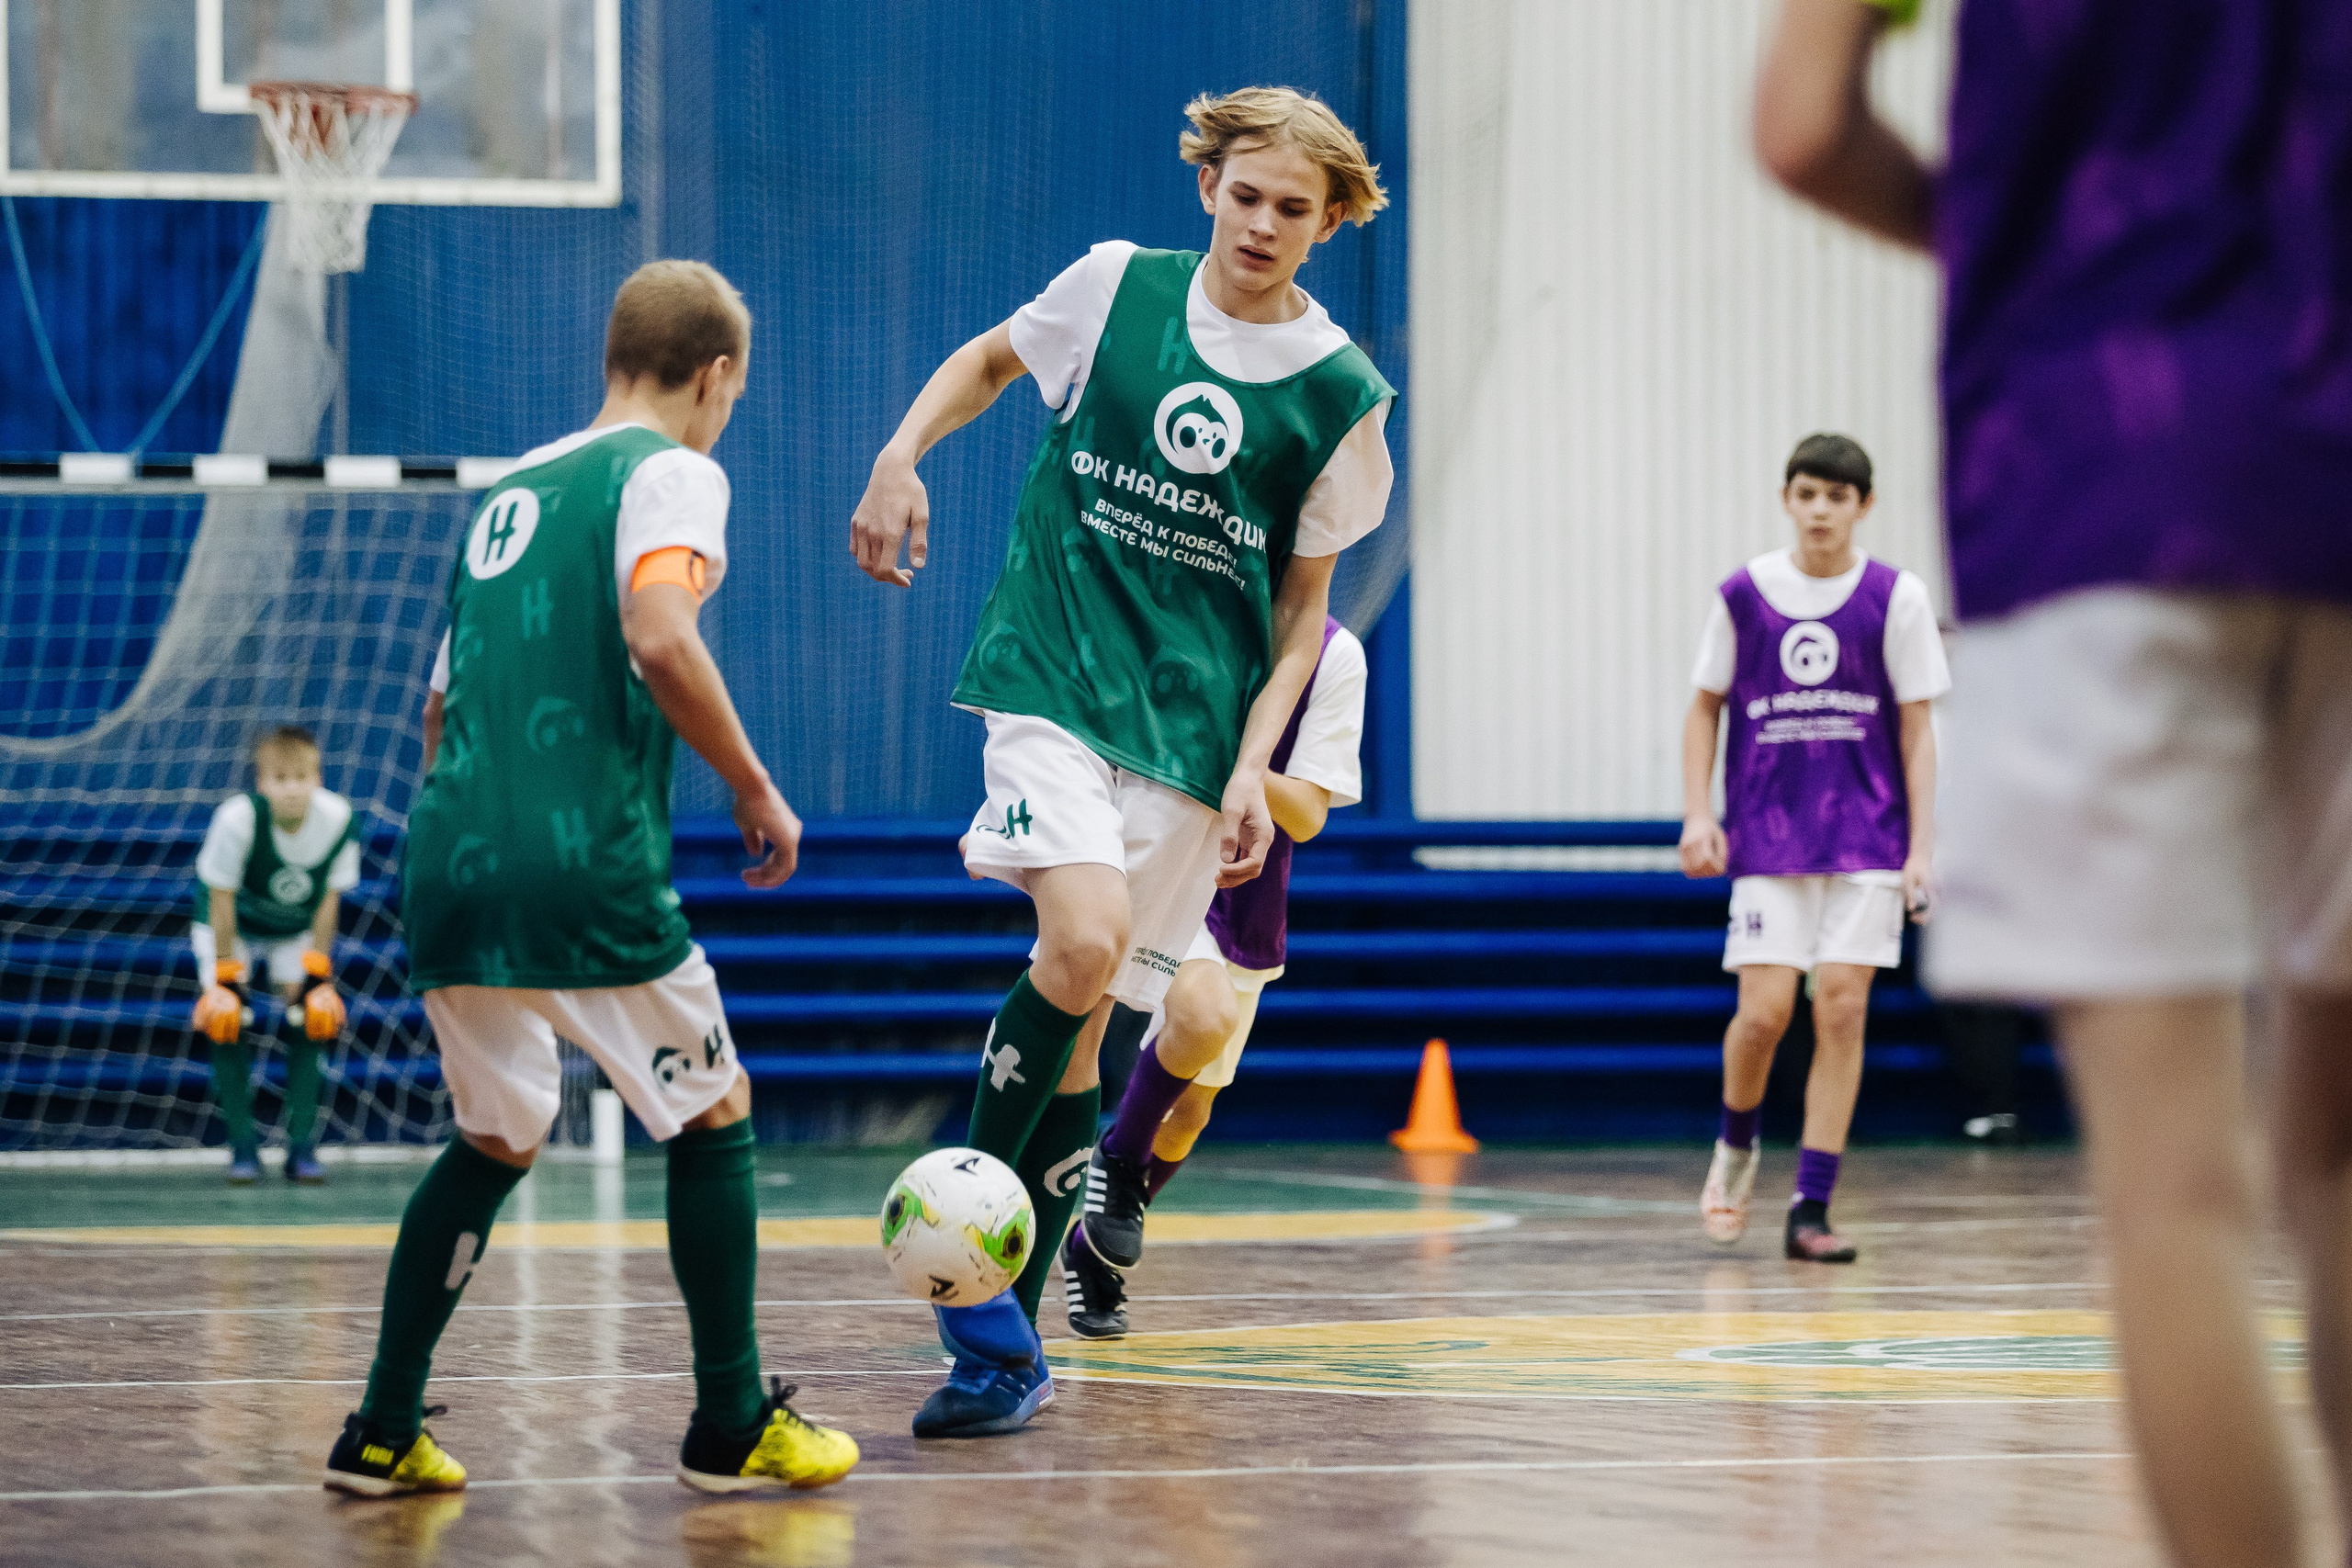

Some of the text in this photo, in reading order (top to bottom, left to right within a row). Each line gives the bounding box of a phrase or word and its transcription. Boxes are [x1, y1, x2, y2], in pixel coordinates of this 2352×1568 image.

[1071, 450, 1267, 554] ФК НАДЕЖДИК
[1094, 498, 1153, 536] ВПЕРЁД
[1157, 525, 1170, 540] К
[1080, 510, 1137, 546] ВМЕСТЕ
[1140, 536, 1170, 558] МЫ
